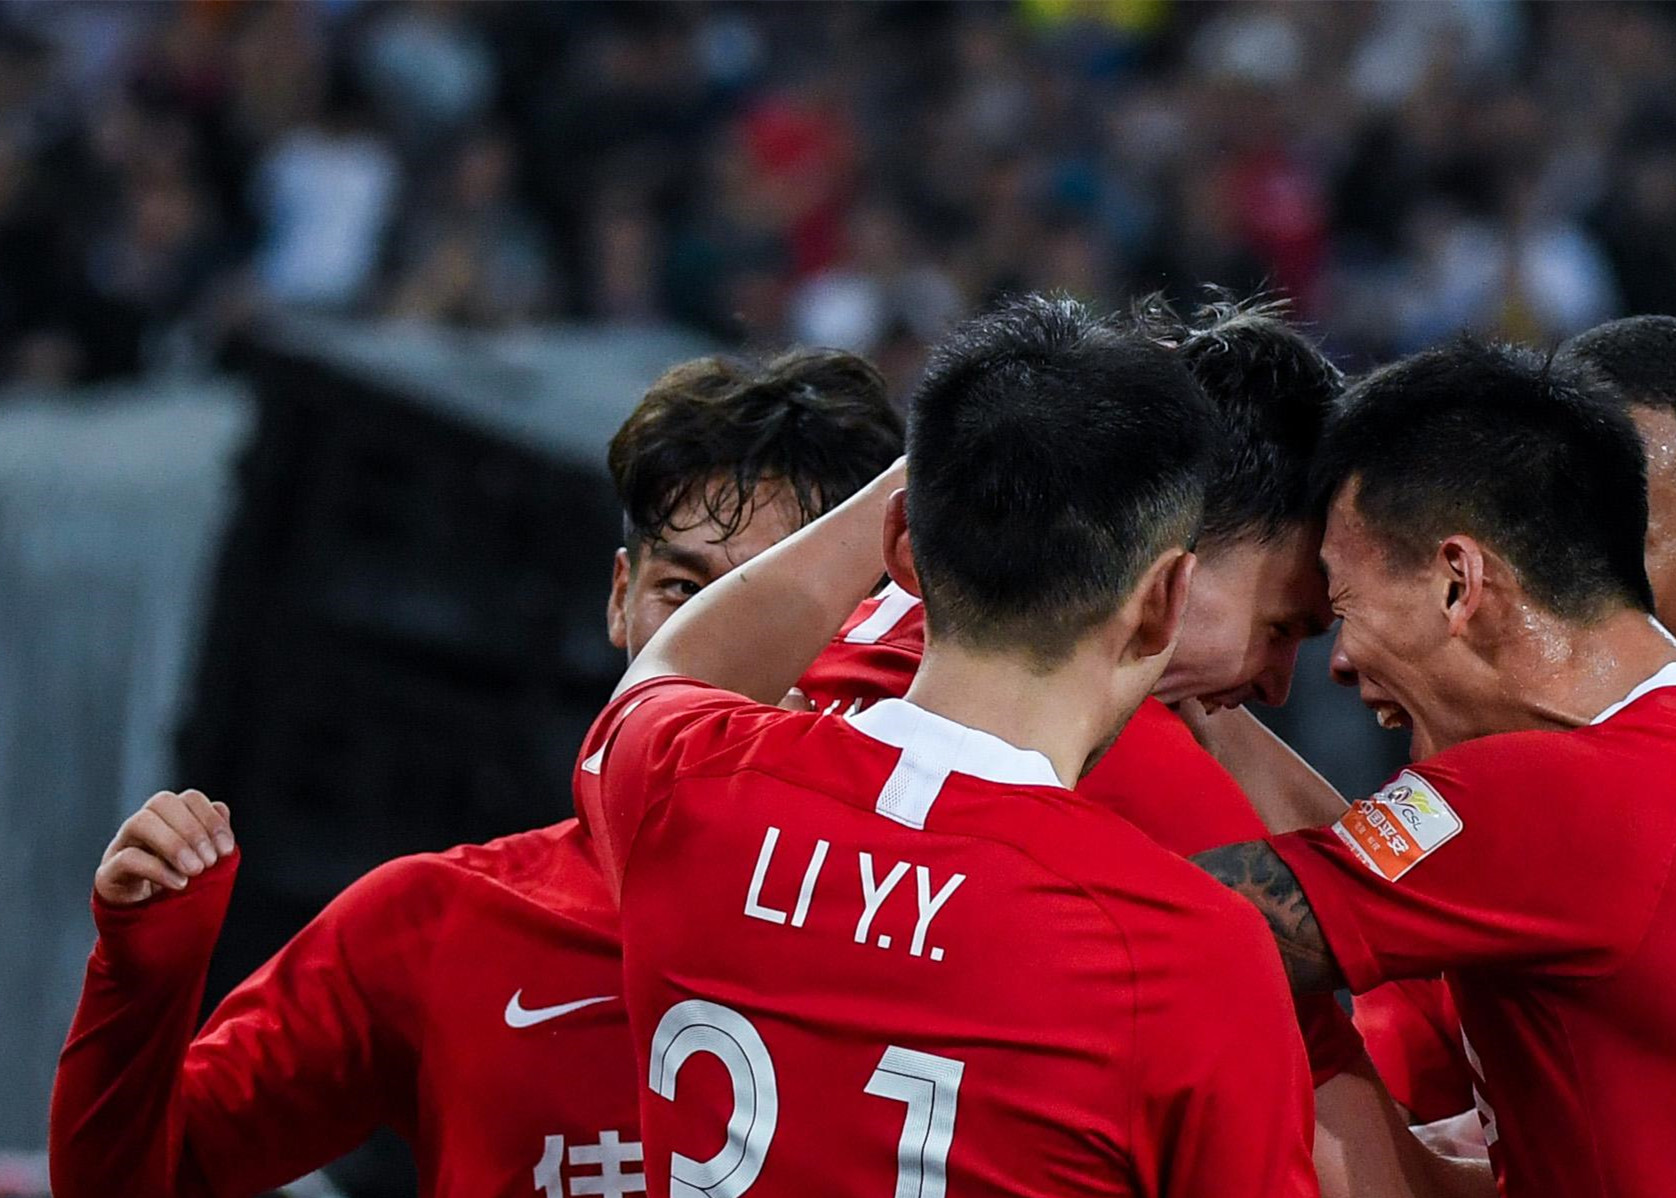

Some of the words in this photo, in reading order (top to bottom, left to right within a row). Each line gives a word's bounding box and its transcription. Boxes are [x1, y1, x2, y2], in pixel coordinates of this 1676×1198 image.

[1401, 808, 1422, 831] CSL
[743, 826, 830, 928] LI
[854, 851, 966, 962] Y.Y.
